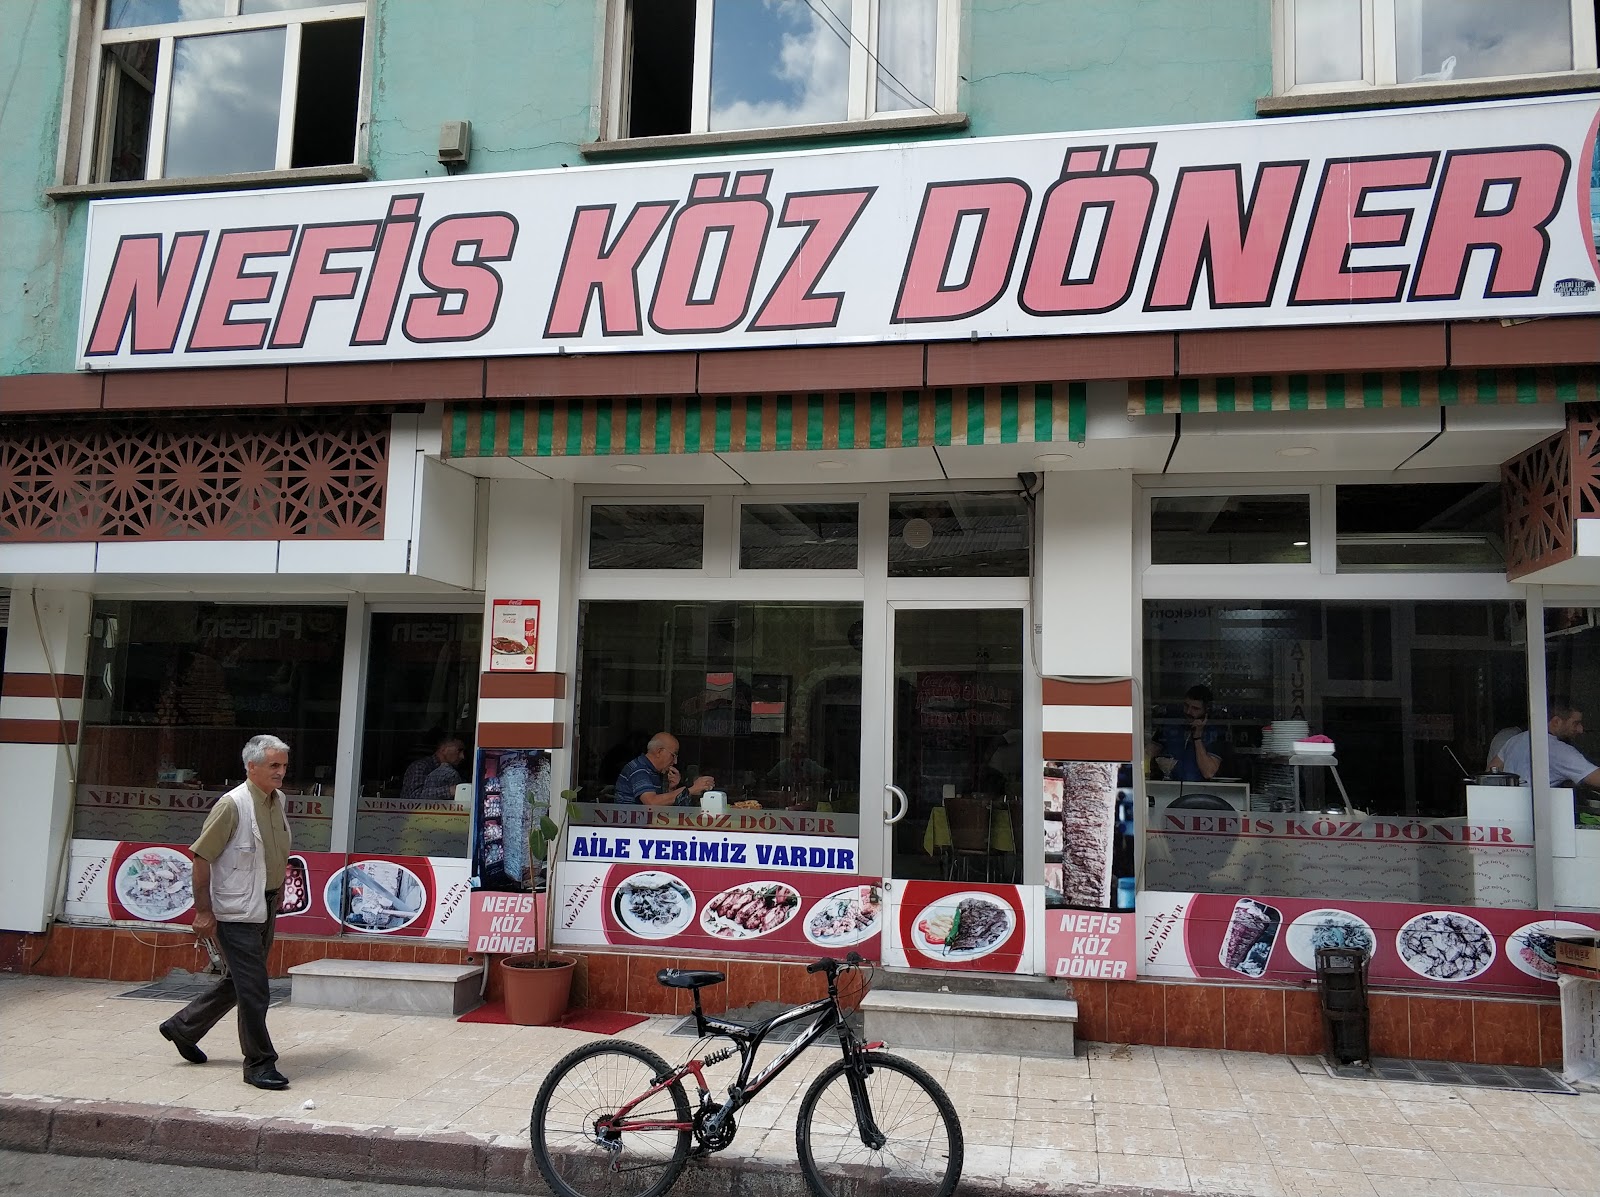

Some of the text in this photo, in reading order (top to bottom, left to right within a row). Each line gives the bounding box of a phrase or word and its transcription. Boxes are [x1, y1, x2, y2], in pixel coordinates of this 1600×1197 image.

[84, 141, 1571, 356] NEFİS KÖZ DÖNER
[88, 790, 161, 806] NEFİS
[593, 808, 835, 832] NEFİS KÖZ DÖNER
[1165, 815, 1515, 842] NEFİS KÖZ DÖNER
[573, 832, 854, 870] AİLE YERİMİZ VARDIR
[481, 894, 534, 913] NEFİS
[490, 914, 524, 933] KÖZ
[1060, 913, 1121, 934] NEFİS
[476, 933, 536, 953] DÖNER
[1071, 934, 1111, 956] KÖZ
[1055, 956, 1127, 978] DÖNER
